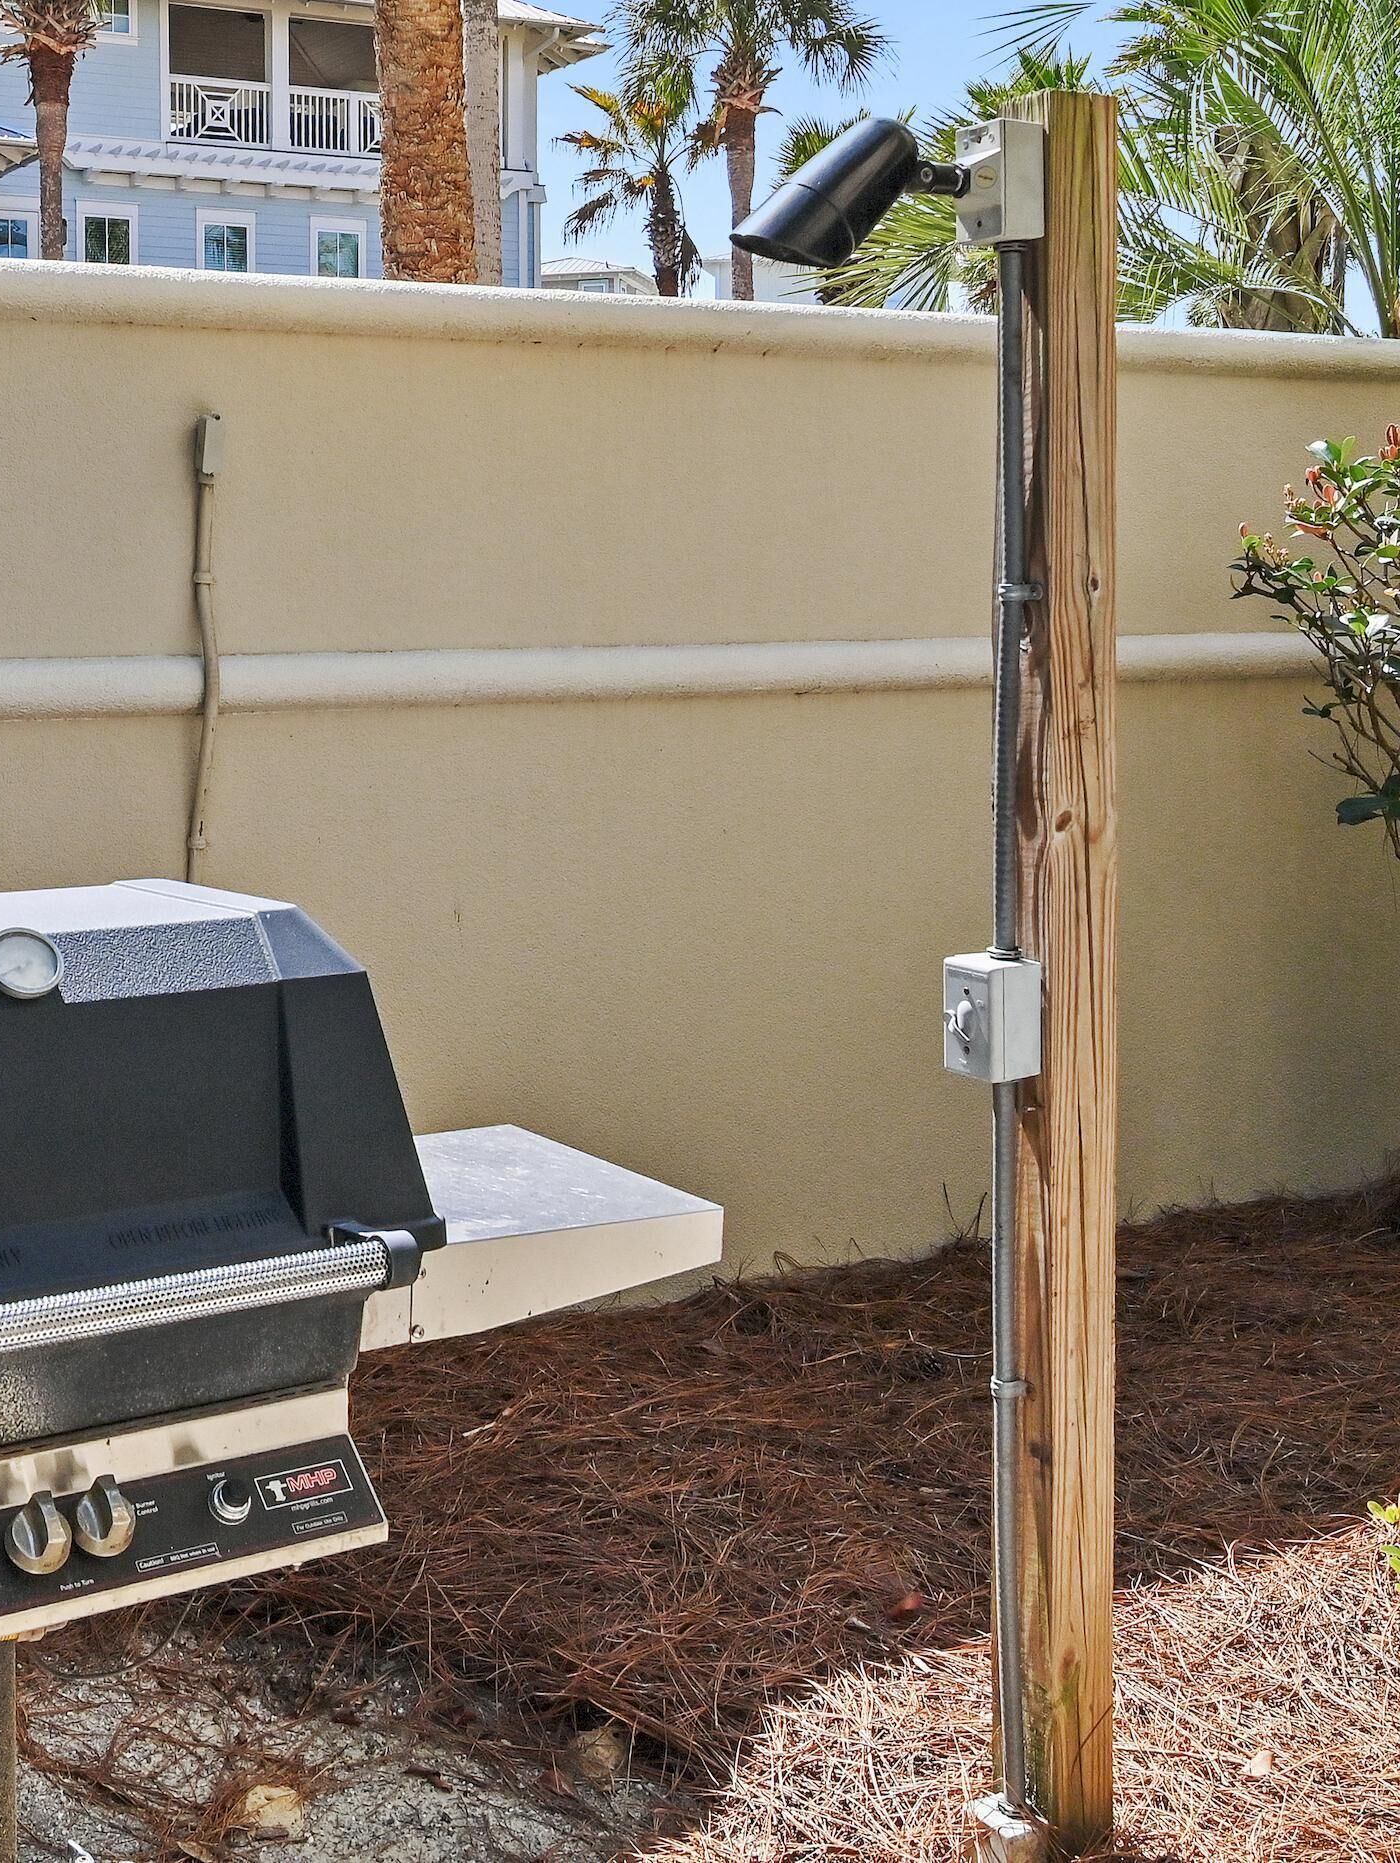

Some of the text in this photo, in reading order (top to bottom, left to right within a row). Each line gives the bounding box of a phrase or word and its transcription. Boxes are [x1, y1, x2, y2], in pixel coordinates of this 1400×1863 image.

[286, 1468, 337, 1492] MHP
[136, 1506, 159, 1516] Control
[60, 1583, 74, 1591] Push
